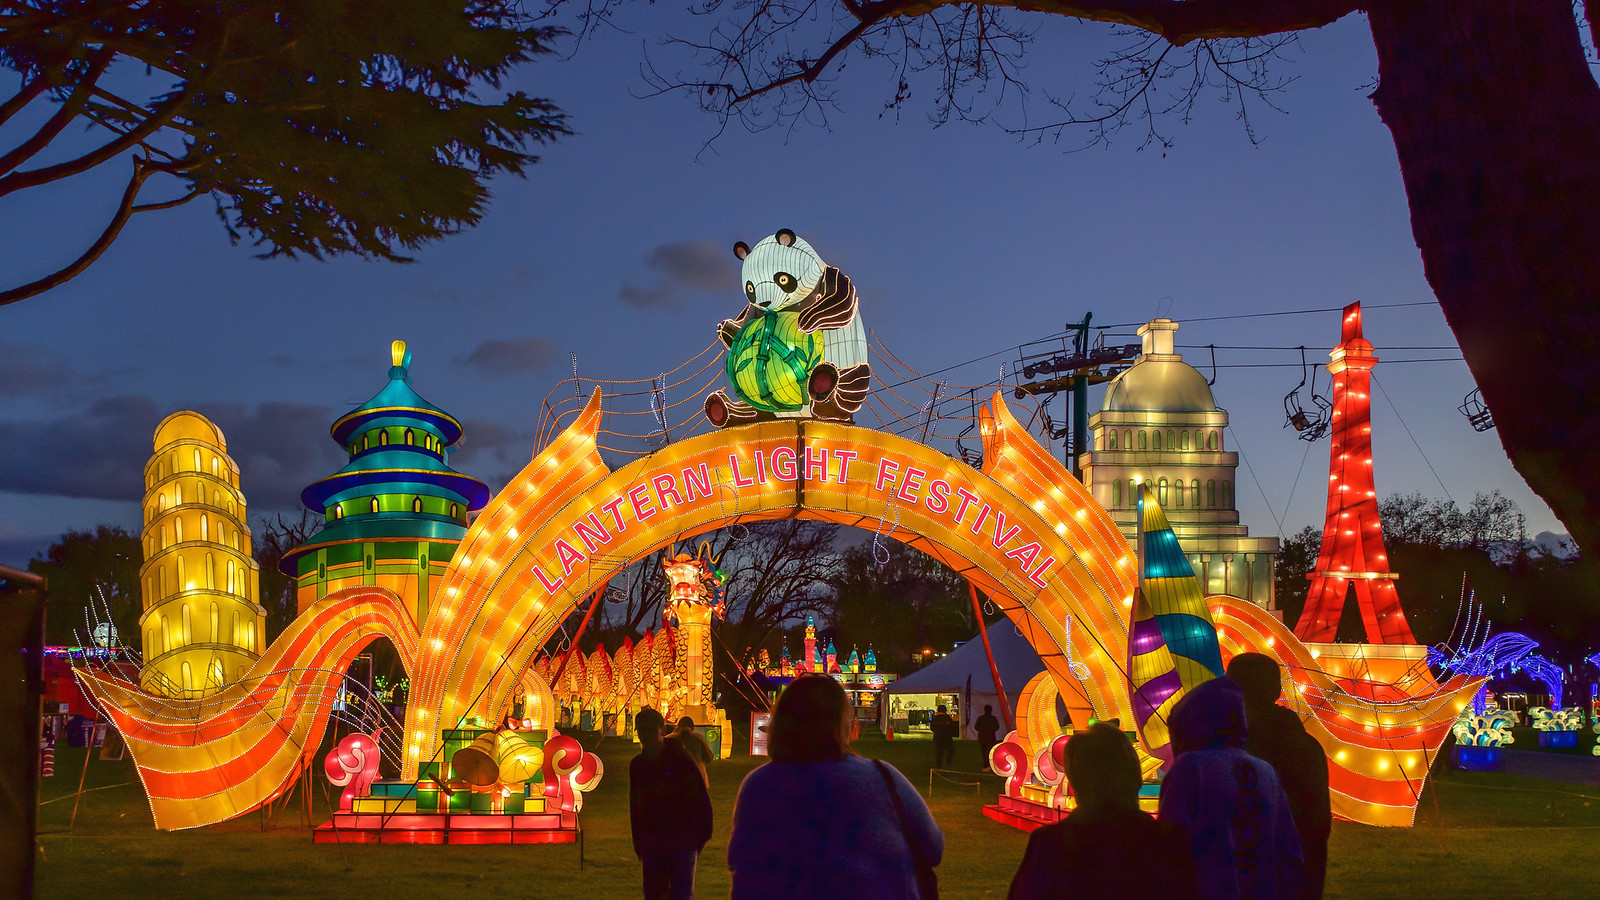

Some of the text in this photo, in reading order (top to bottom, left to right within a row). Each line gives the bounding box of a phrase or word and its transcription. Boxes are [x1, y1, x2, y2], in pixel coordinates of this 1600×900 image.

[531, 446, 1056, 596] LANTERN LIGHT FESTIVAL
[1230, 761, 1261, 900] didas
